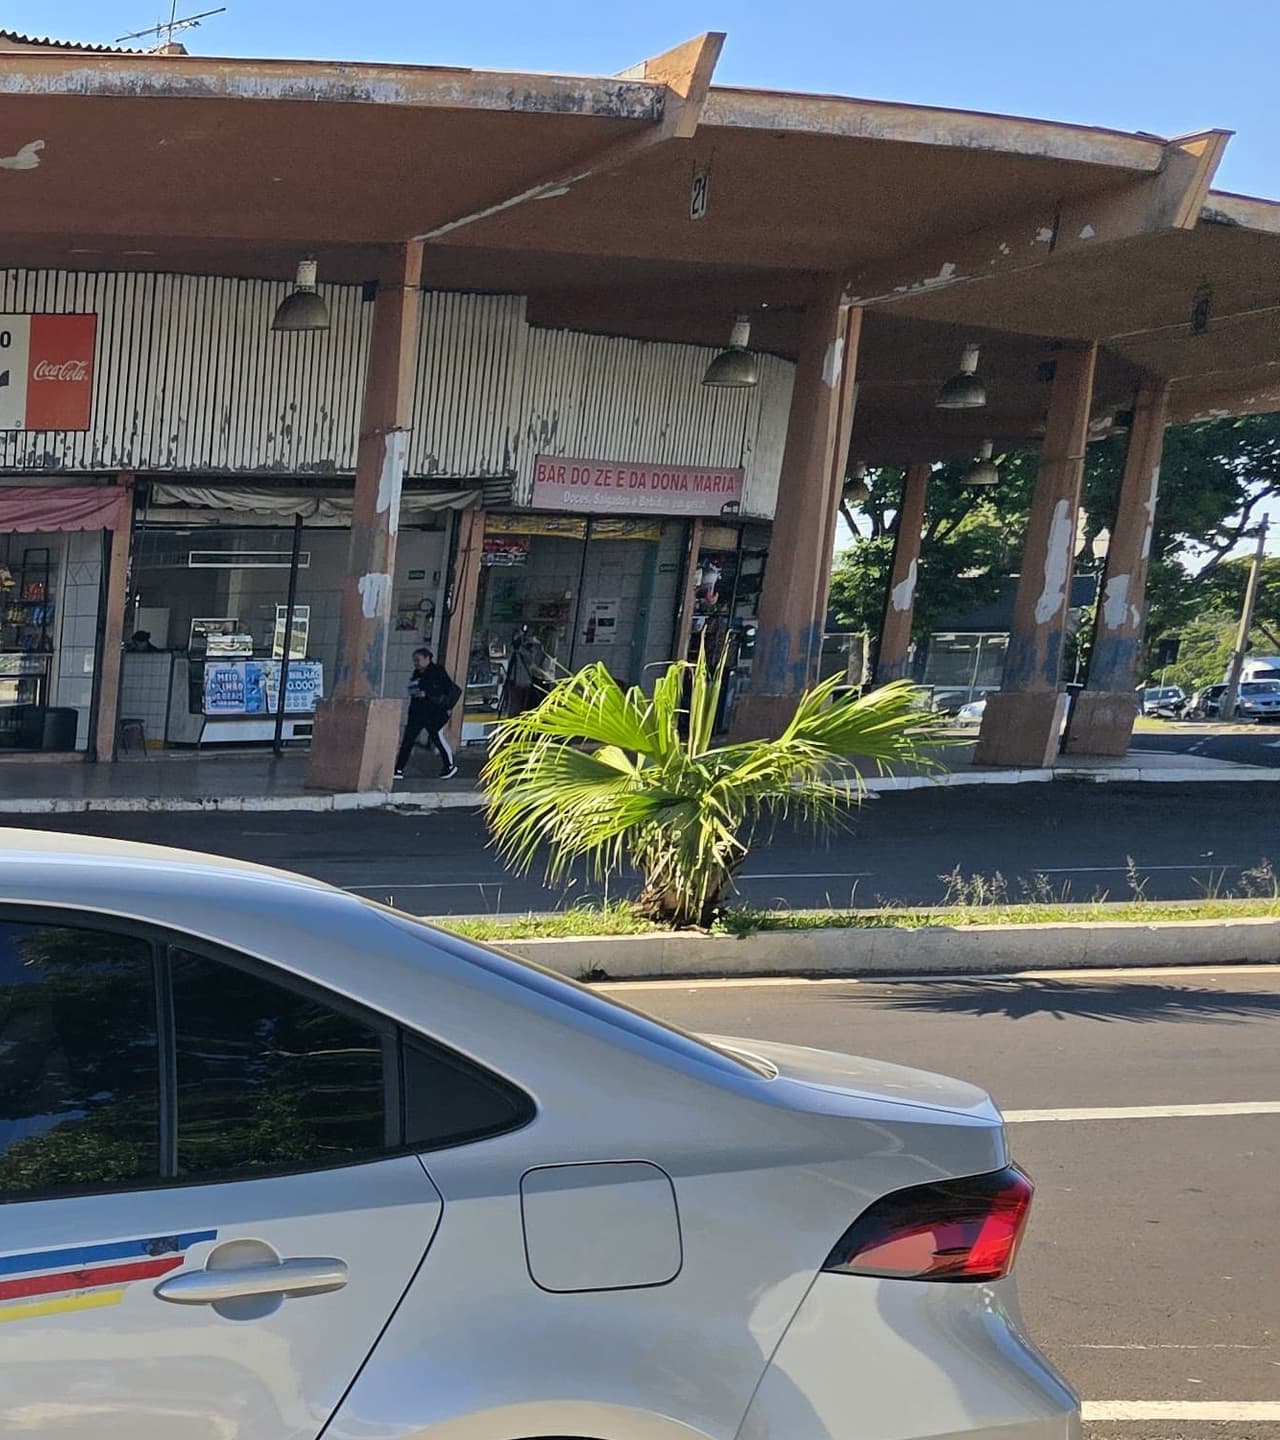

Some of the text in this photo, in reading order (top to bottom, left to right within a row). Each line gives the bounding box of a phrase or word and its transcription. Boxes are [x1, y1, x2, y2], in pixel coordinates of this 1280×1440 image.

[537, 464, 566, 485] BAR
[570, 467, 590, 486] DO
[616, 470, 625, 488] E
[629, 471, 647, 489] DA
[651, 473, 689, 491] DONA
[693, 474, 735, 493] MARIA
